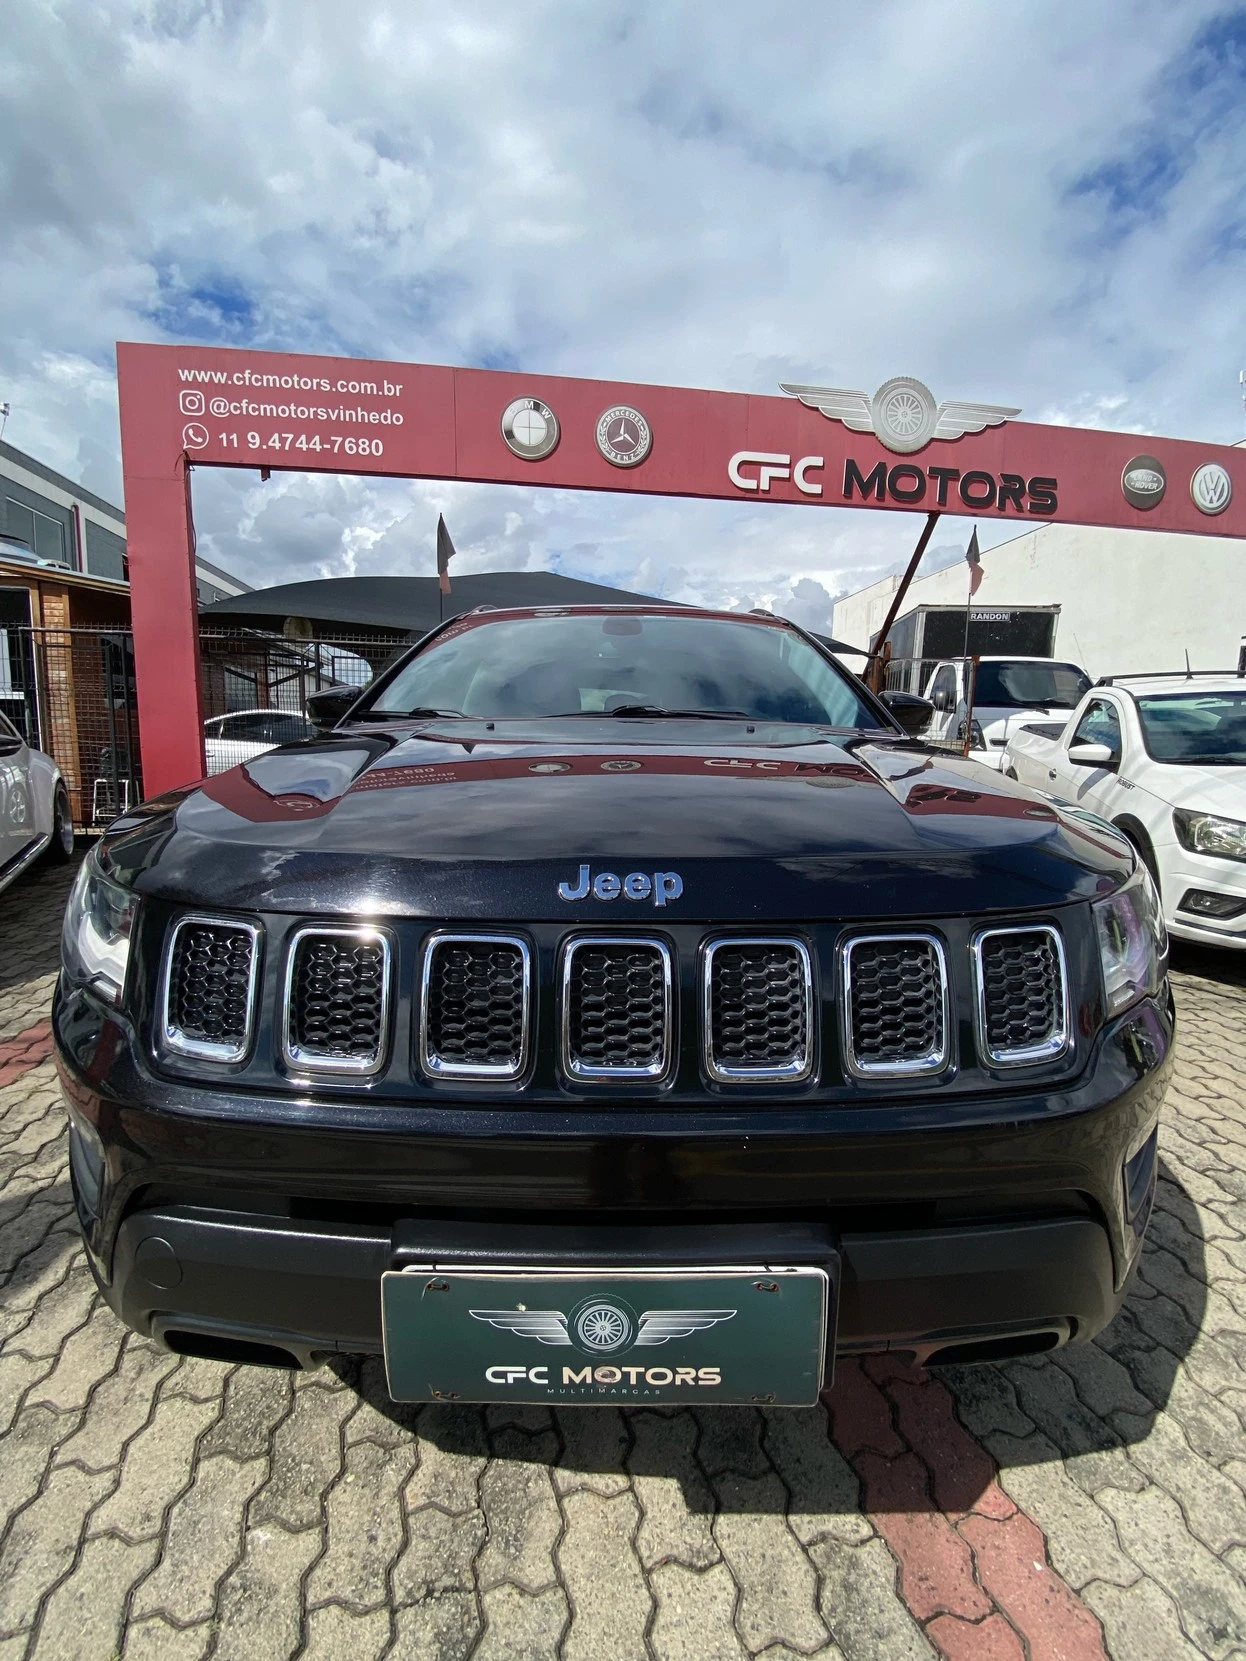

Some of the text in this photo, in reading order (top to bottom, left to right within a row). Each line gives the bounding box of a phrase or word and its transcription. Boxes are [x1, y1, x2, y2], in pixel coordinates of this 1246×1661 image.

[178, 369, 403, 397] www.cfcmotors.com.br
[209, 397, 404, 426] @cfcmotorsvinhedo
[606, 409, 643, 426] MERCEDES
[218, 431, 384, 457] 11 9.4744-7680
[610, 451, 635, 462] BENZ
[728, 451, 1058, 515] CFC MOTORS
[1135, 481, 1157, 490] ROVER
[970, 612, 1009, 621] RANDON
[558, 864, 684, 907] Jeep
[485, 1366, 722, 1386] CFC MOTORS
